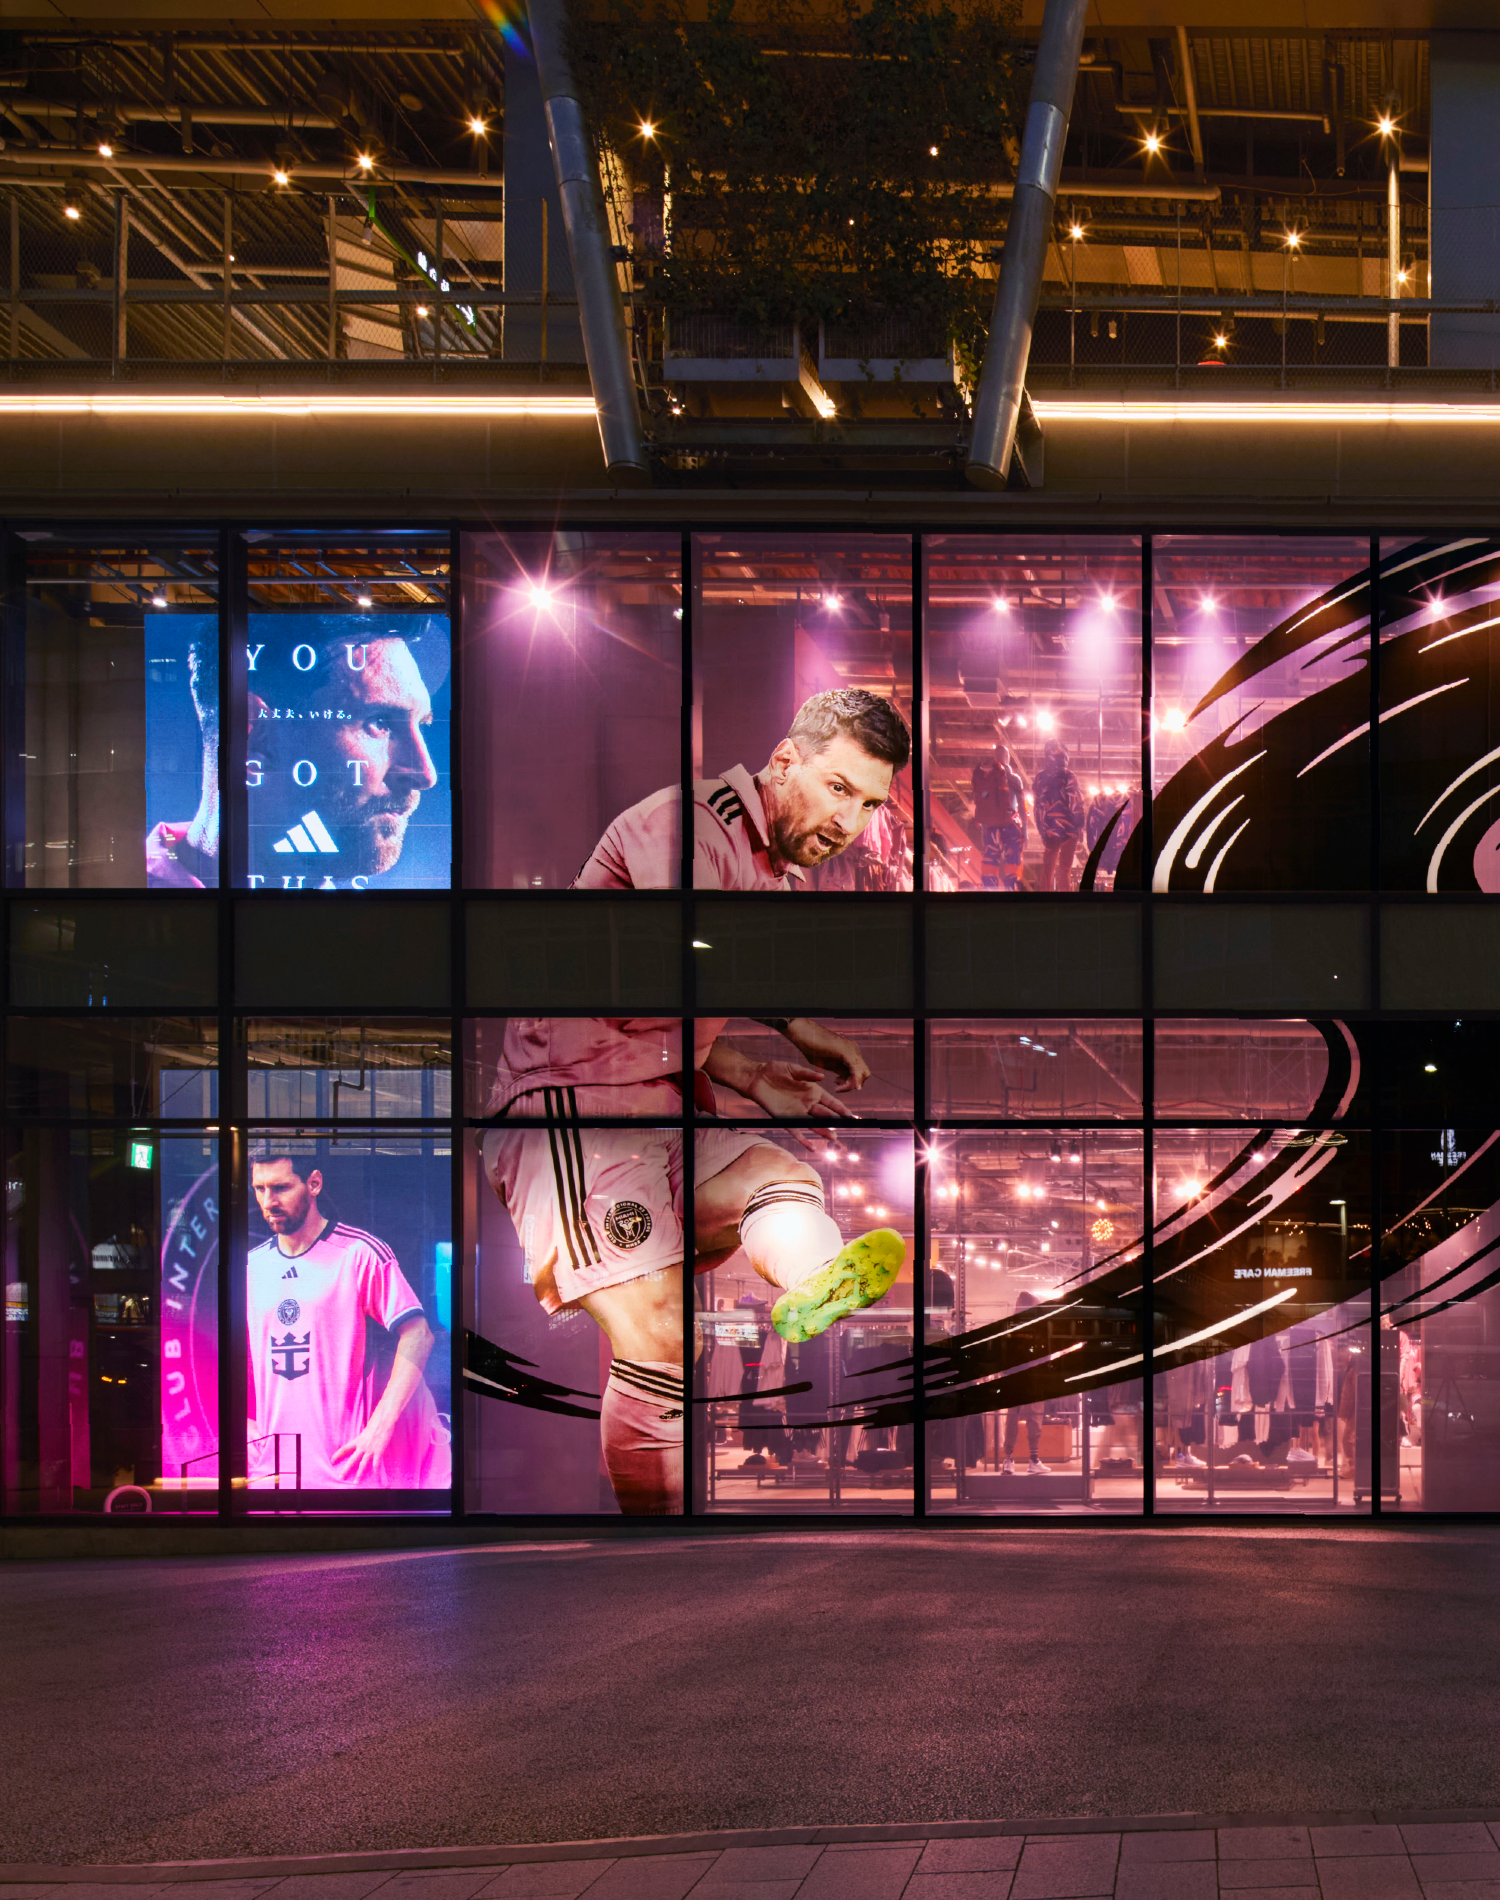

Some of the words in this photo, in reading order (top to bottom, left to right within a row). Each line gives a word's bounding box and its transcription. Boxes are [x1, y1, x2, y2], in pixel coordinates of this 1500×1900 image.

[246, 644, 368, 672] YOU
[245, 760, 369, 786] GOT
[615, 1211, 635, 1221] MIAMI
